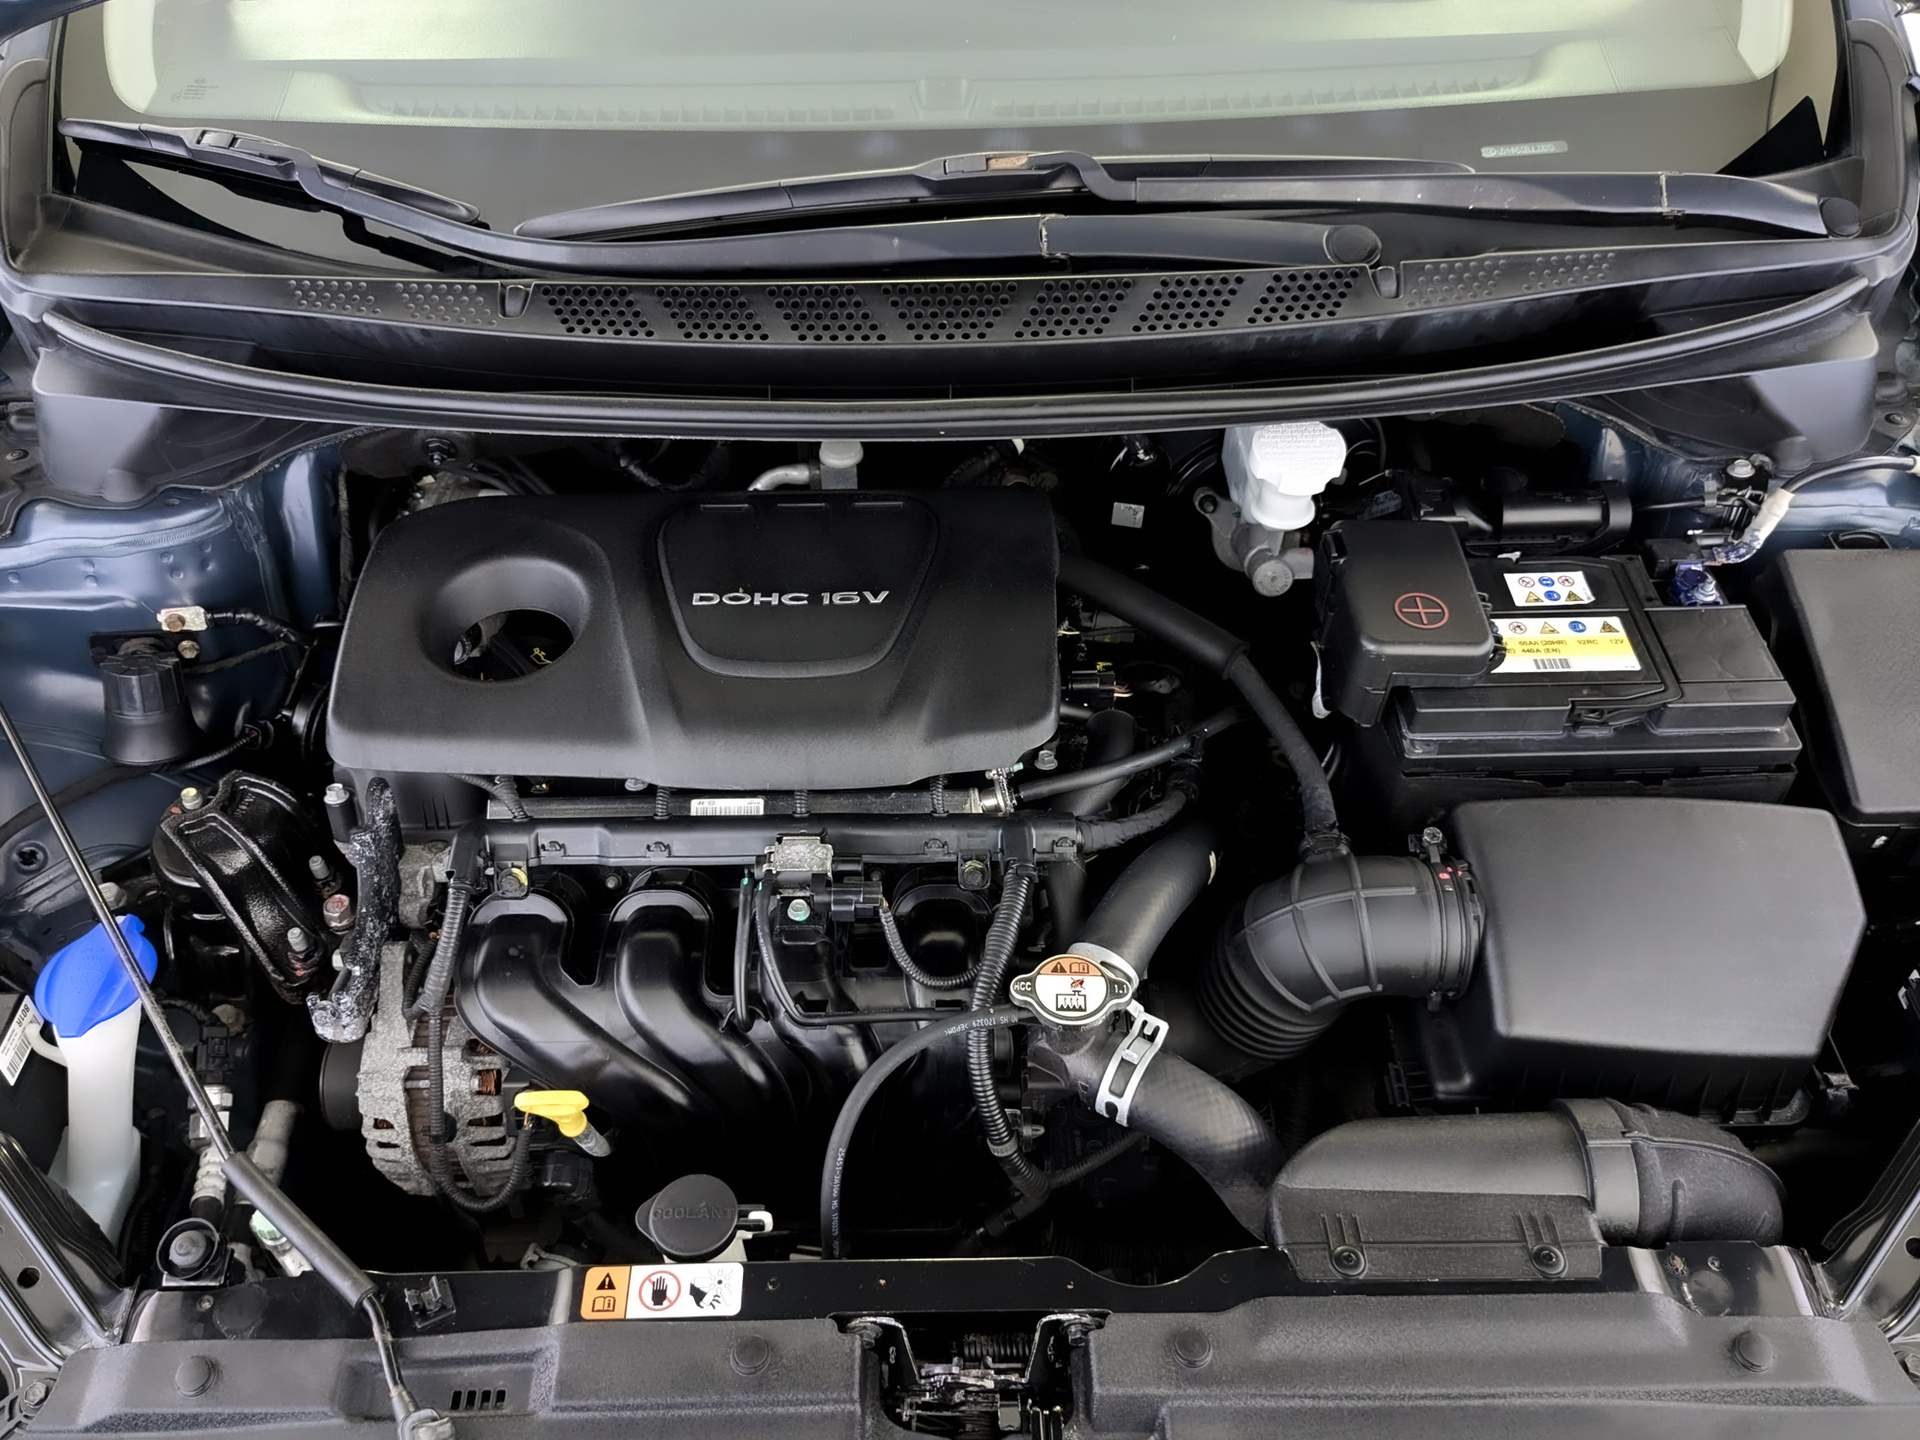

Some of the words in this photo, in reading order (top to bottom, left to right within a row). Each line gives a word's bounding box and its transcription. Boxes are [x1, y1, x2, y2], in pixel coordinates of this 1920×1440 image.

[692, 592, 809, 606] DOHC
[821, 591, 890, 605] 16V
[1013, 981, 1032, 991] HCC
[1113, 984, 1127, 994] 1.1
[972, 1017, 997, 1028] 170329
[652, 1205, 736, 1219] COOLANT
